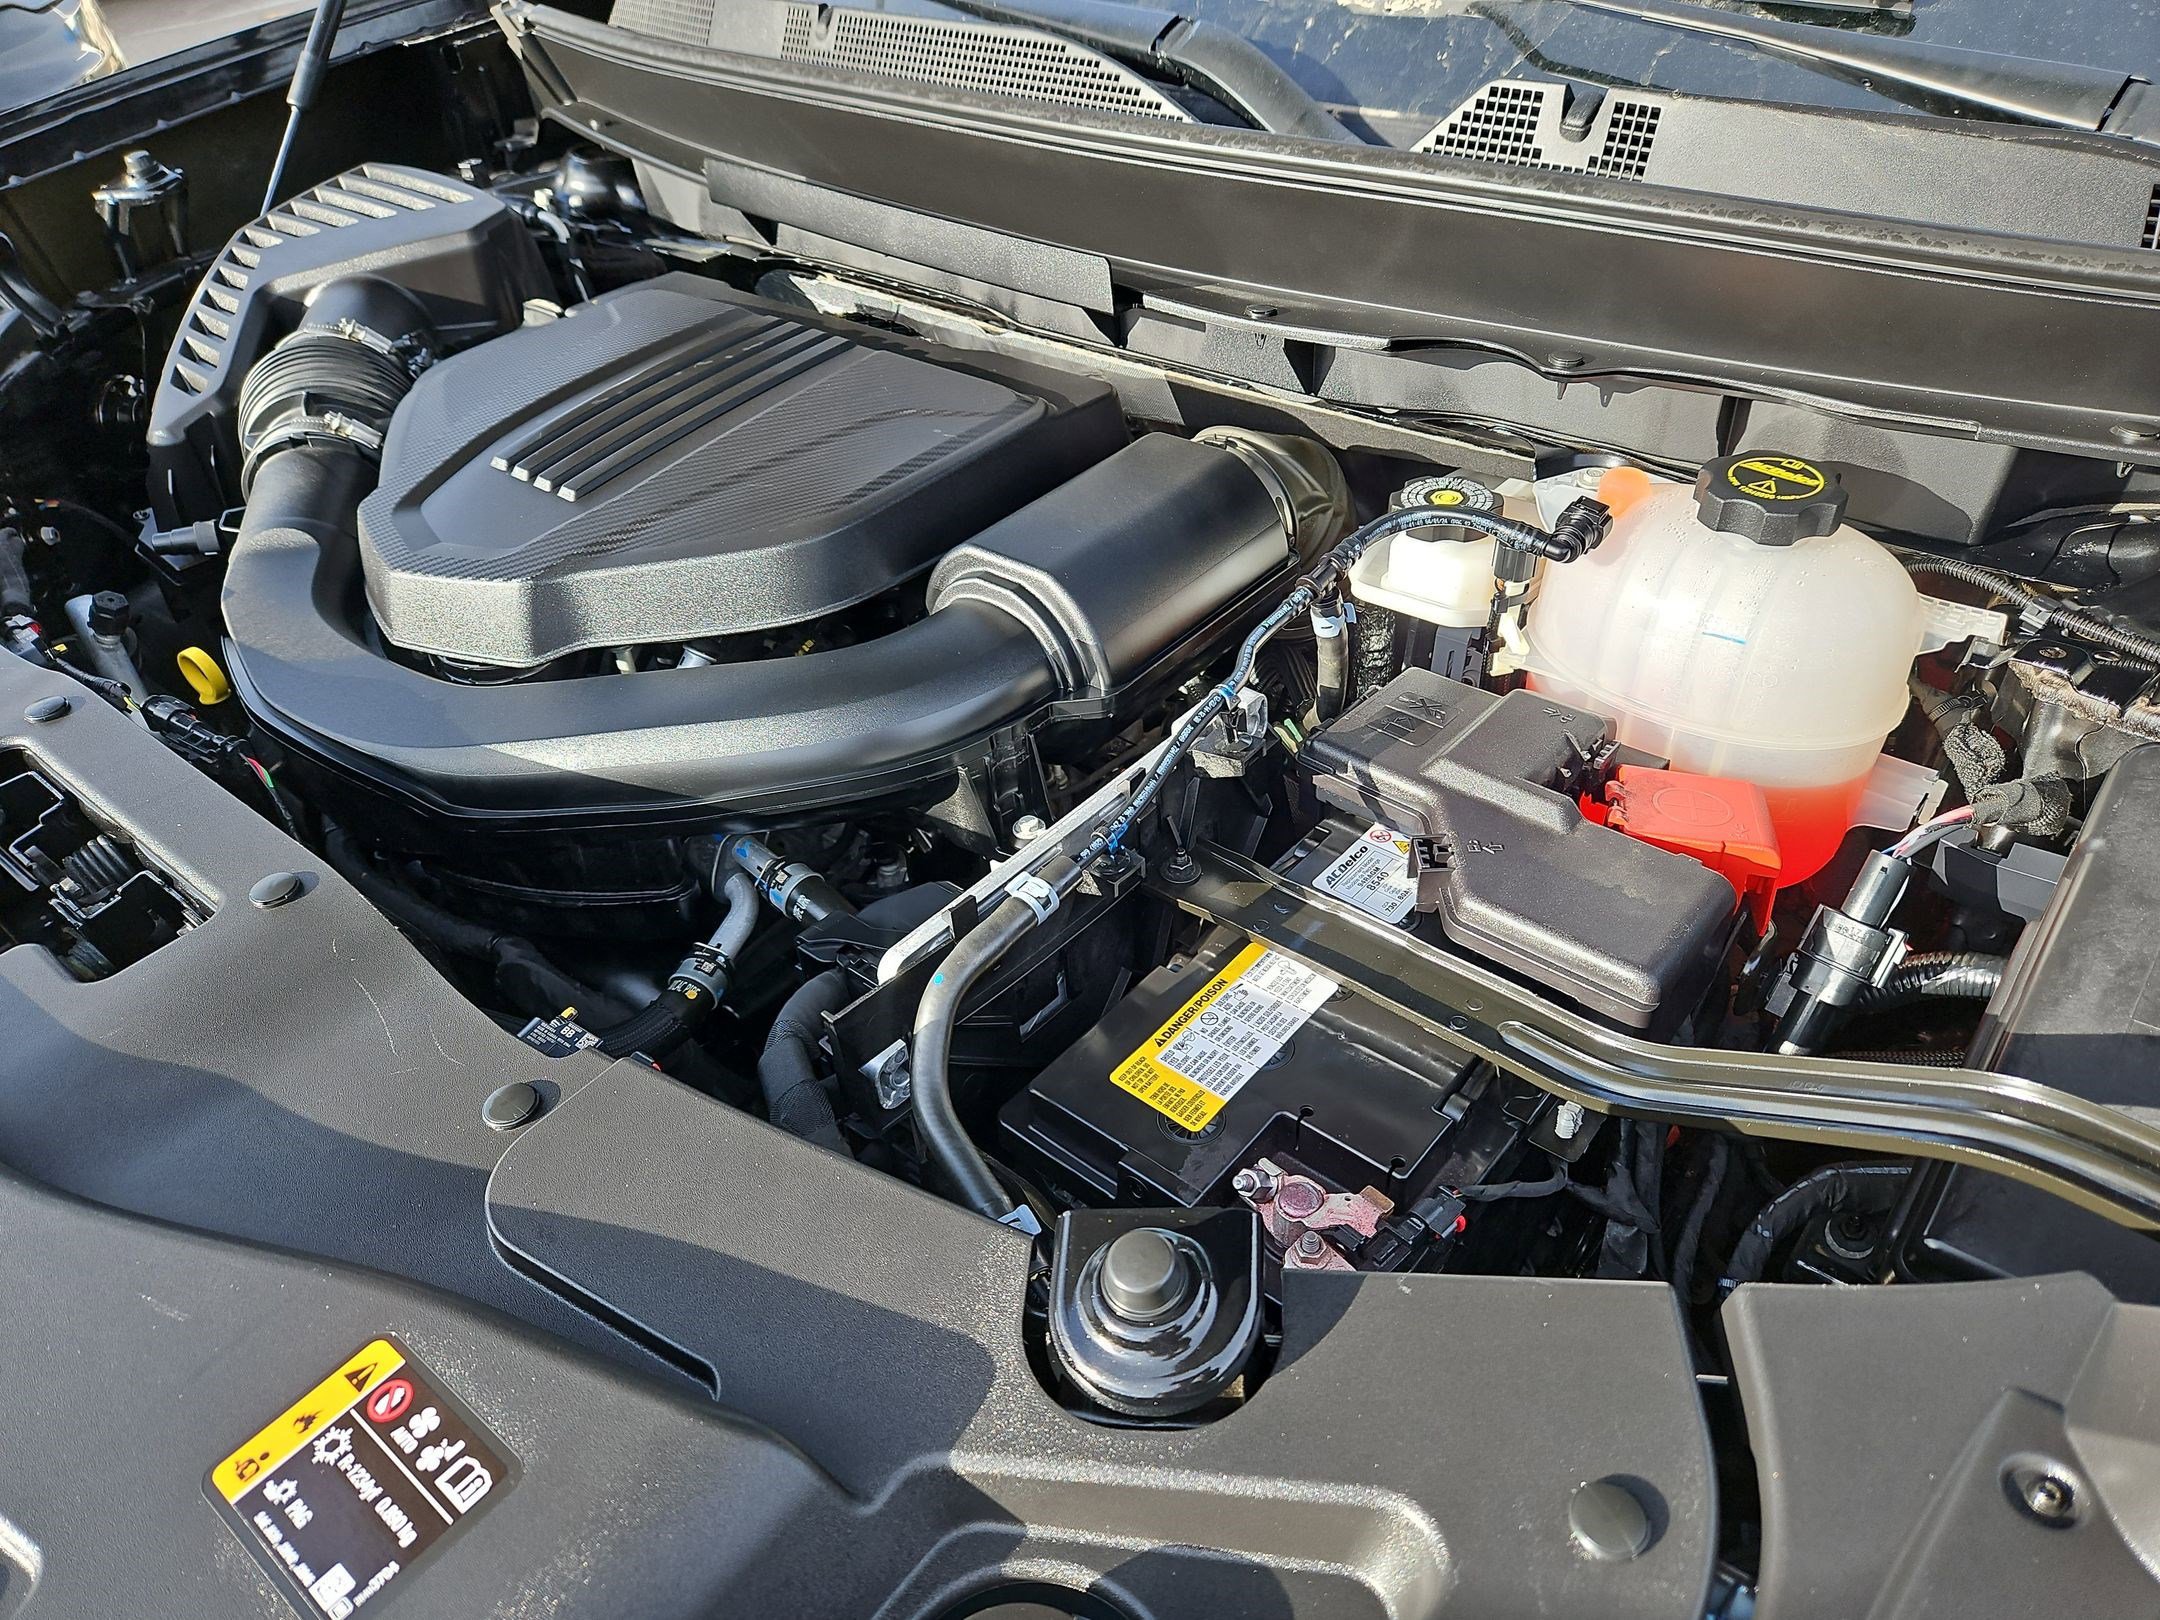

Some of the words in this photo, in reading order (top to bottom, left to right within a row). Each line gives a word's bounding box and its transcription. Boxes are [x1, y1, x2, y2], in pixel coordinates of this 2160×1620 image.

[1325, 845, 1369, 887] ACDelco
[1357, 866, 1381, 888] 94RAGM
[1366, 871, 1389, 891] 8540
[1384, 900, 1398, 914] 730
[1162, 978, 1230, 1041] DANGER/POISON
[336, 1452, 384, 1504] R-1234yf
